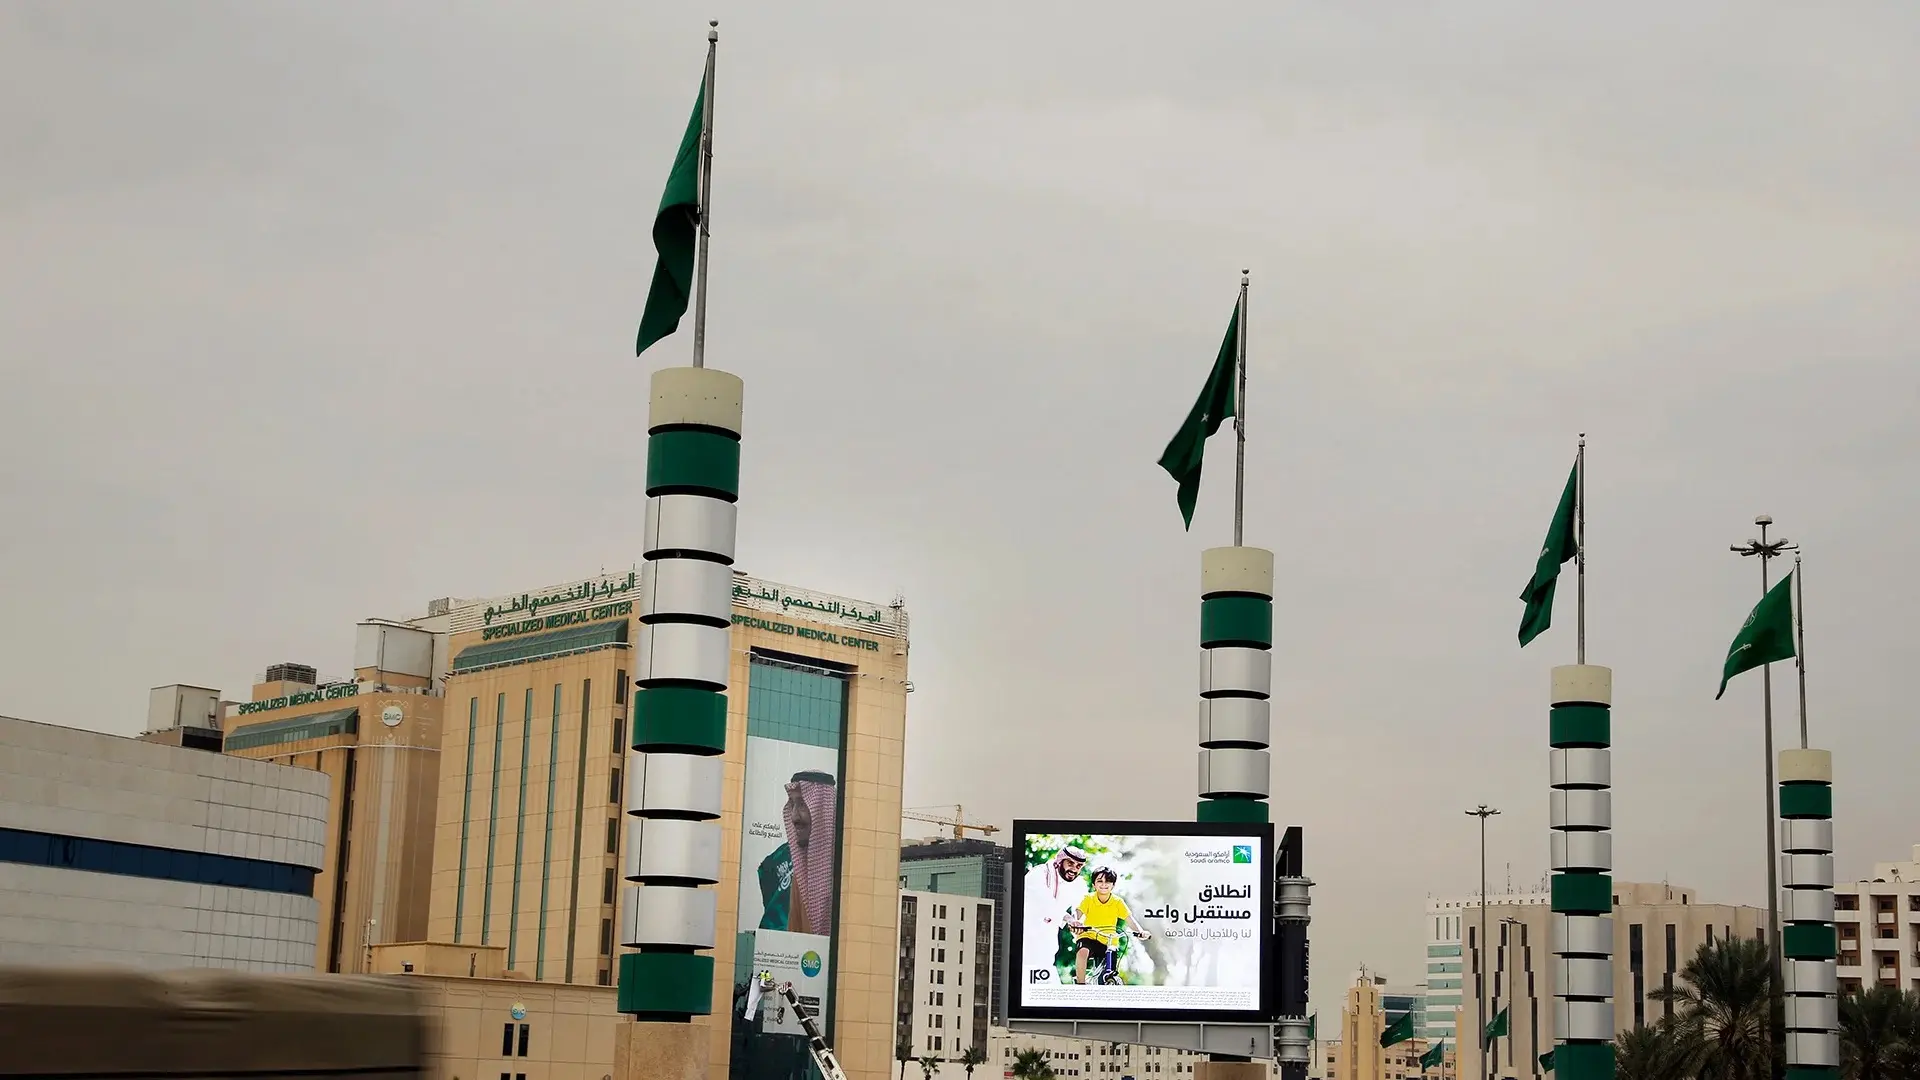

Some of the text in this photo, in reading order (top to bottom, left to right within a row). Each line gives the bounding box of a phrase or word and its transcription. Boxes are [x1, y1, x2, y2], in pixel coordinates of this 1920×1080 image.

[484, 572, 635, 626] المركز التخصصي الطبي
[781, 594, 840, 614] التخصصي
[482, 600, 633, 641] SPECIALIZED MEDICAL CENTER
[839, 604, 881, 624] المركز
[730, 613, 879, 652] SPECIALIZED MEDICAL CENTER
[238, 683, 359, 716] SPECIALIZED MEDICAL CENTER
[1198, 884, 1251, 902] انطلاق
[1144, 904, 1251, 923] مستقبل واعد
[1165, 928, 1198, 938] القادمة
[1241, 928, 1252, 938] لنا
[802, 959, 820, 969] SMC
